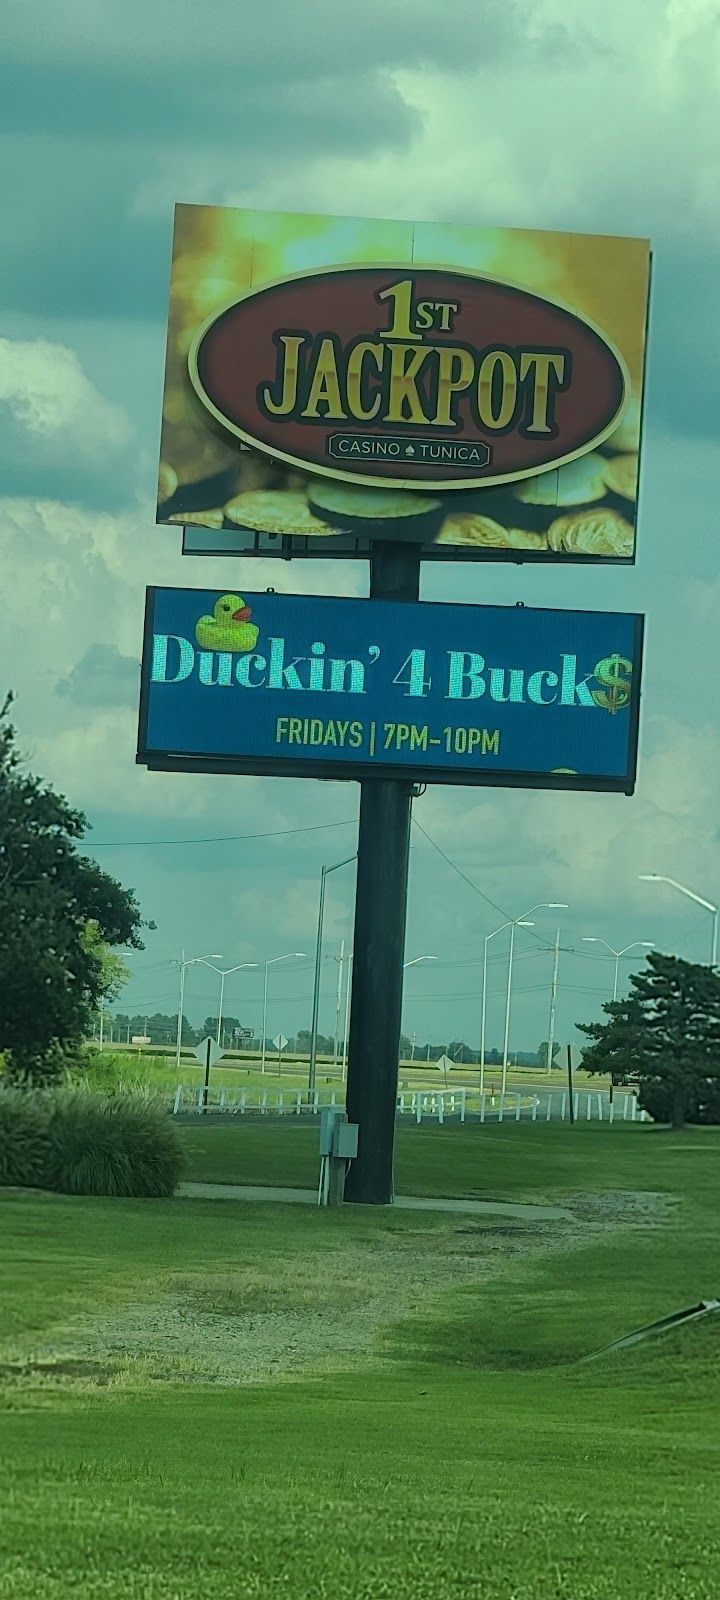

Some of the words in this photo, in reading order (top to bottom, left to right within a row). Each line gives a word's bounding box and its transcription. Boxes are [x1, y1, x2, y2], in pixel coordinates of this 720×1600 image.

[379, 280, 458, 341] 1ST
[263, 335, 565, 433] JACKPOT
[338, 439, 400, 455] CASINO
[420, 444, 480, 460] TUNICA
[150, 633, 380, 695] Duckin'
[392, 648, 432, 698] 4
[444, 649, 633, 715] Buck$
[275, 717, 363, 748] FRIDAYS
[383, 723, 500, 756] 7PM-10PM
